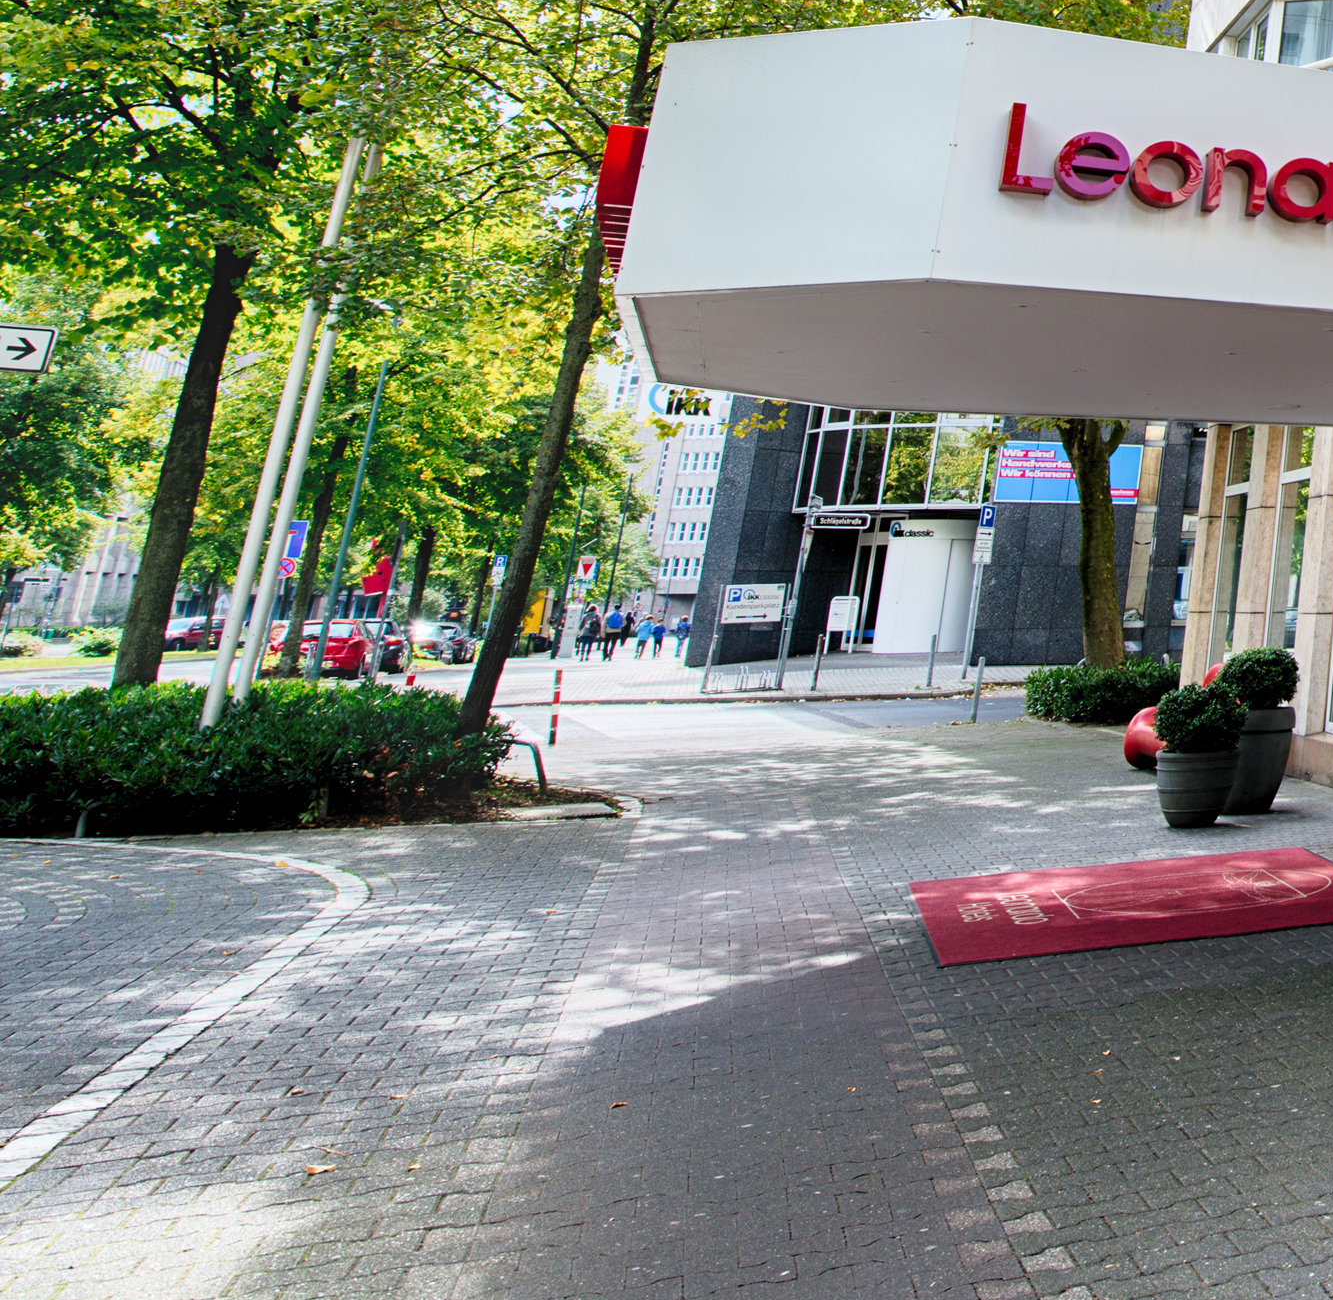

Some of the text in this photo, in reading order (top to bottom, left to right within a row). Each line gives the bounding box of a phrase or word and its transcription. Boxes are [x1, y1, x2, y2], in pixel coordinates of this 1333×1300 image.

[1003, 449, 1026, 457] Wir
[1001, 459, 1072, 469] Handwerke
[1000, 469, 1023, 477] Wir
[982, 508, 993, 525] P
[729, 589, 741, 602] P
